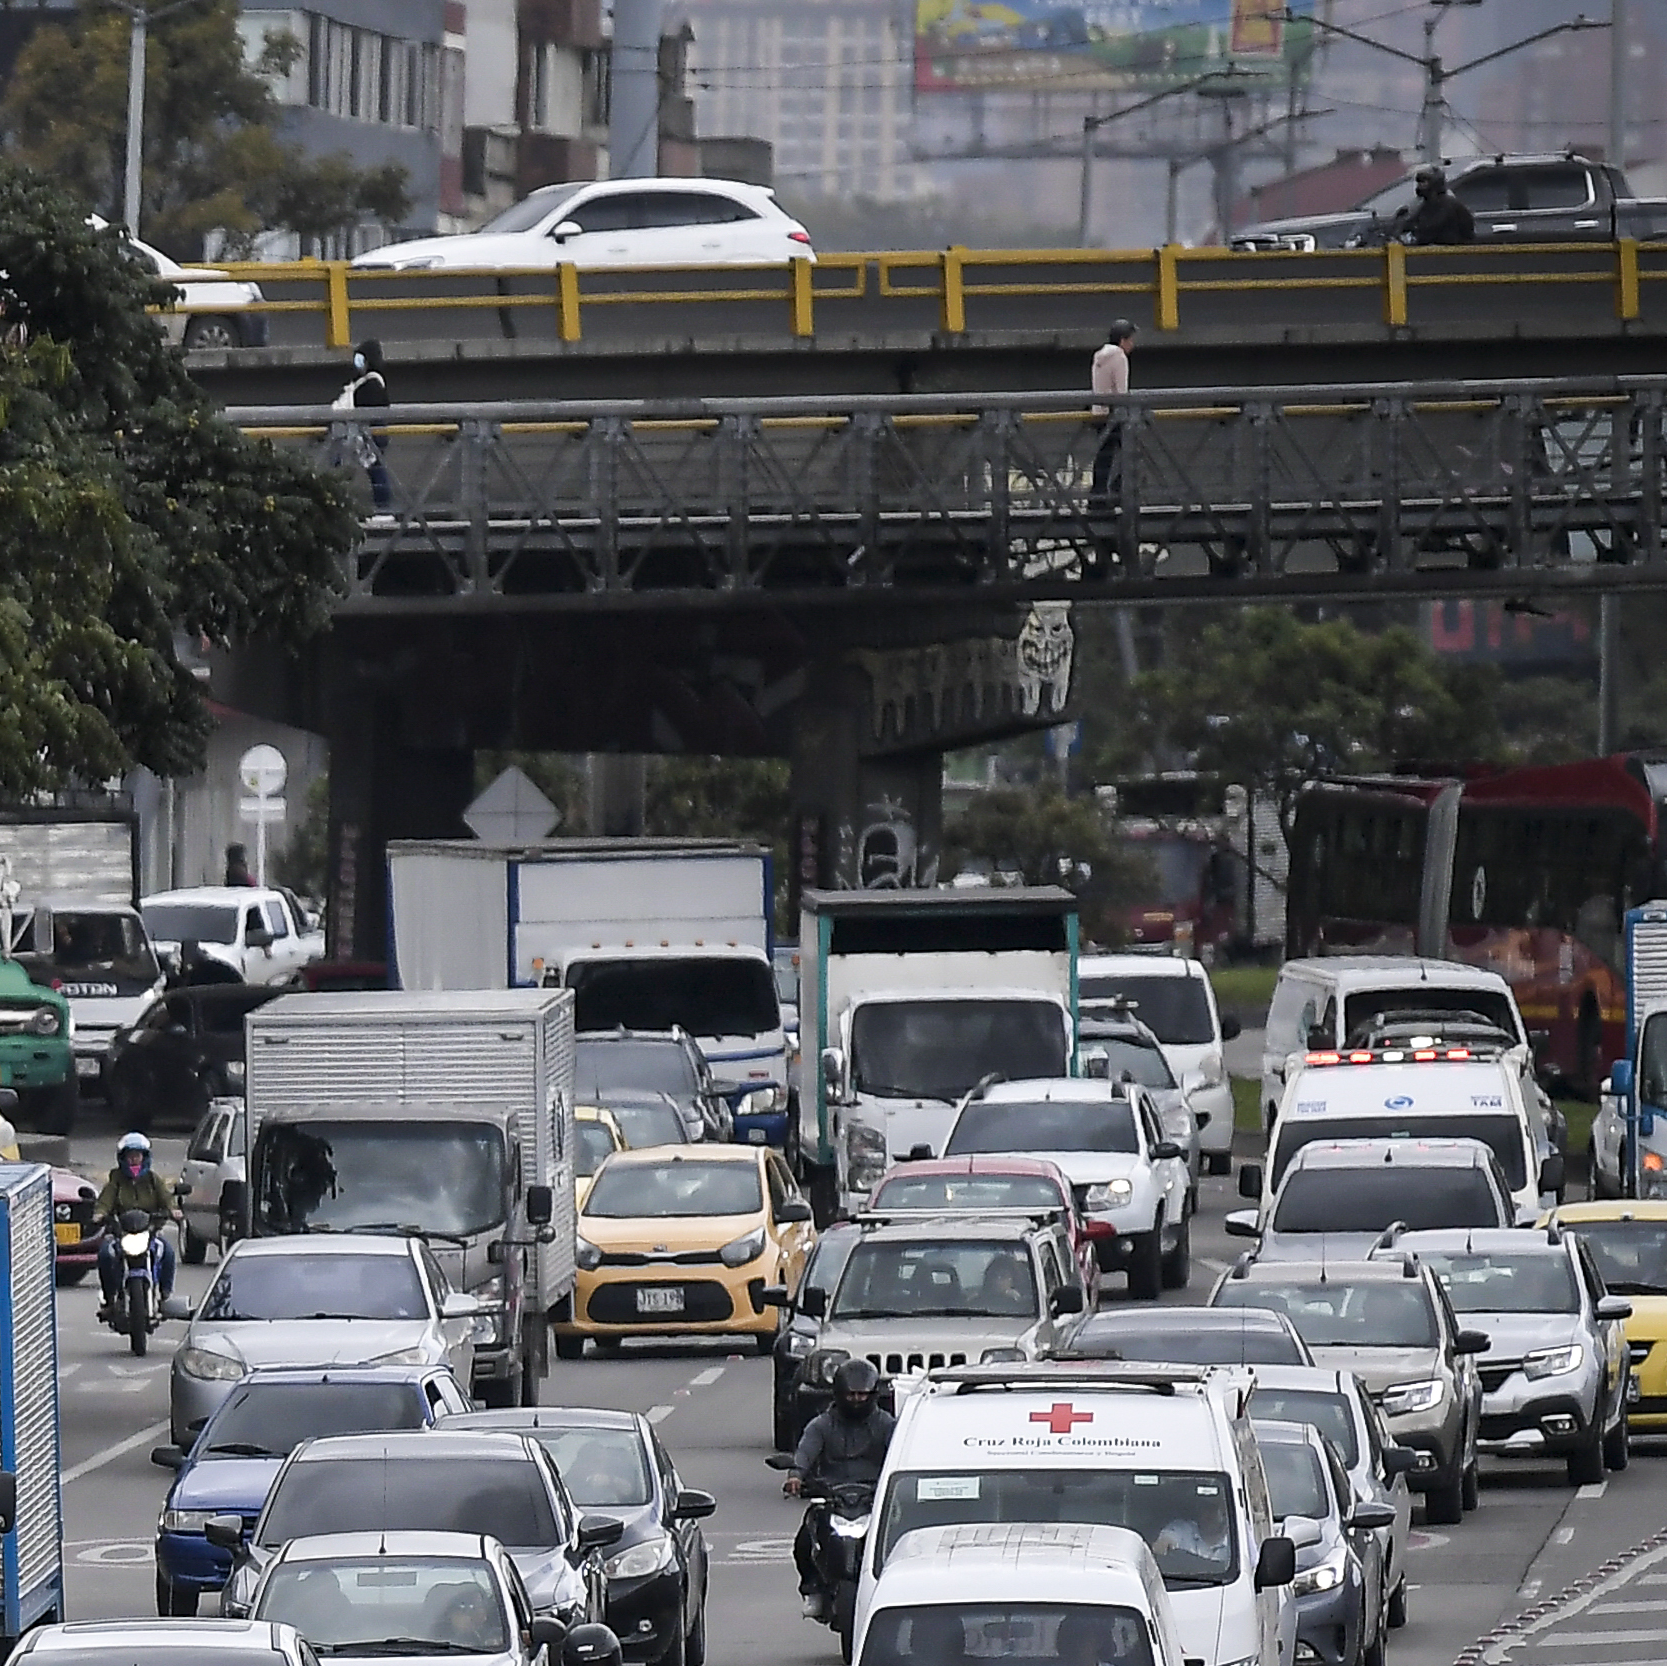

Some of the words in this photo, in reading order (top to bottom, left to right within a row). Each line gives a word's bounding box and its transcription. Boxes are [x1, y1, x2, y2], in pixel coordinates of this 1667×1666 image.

[963, 1437, 1005, 1448] Cruz
[1012, 1437, 1051, 1449] Roja
[1057, 1437, 1161, 1448] Colombiana
